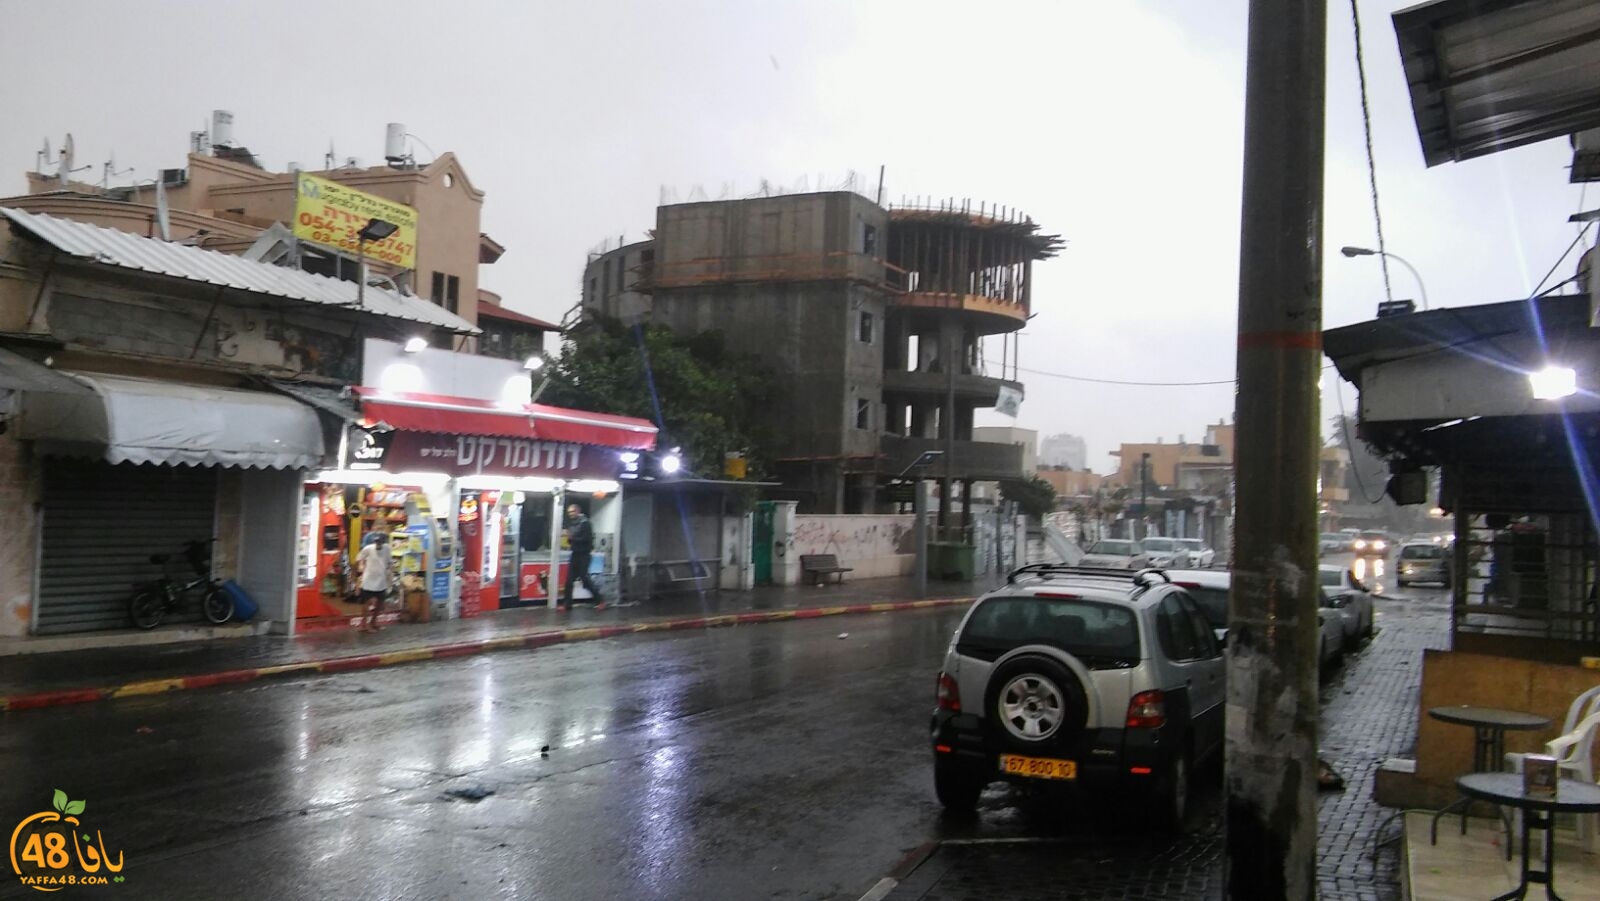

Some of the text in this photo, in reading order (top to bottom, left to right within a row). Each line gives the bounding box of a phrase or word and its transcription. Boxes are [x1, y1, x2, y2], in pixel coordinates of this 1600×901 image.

[1009, 758, 1071, 776] 67 800 10
